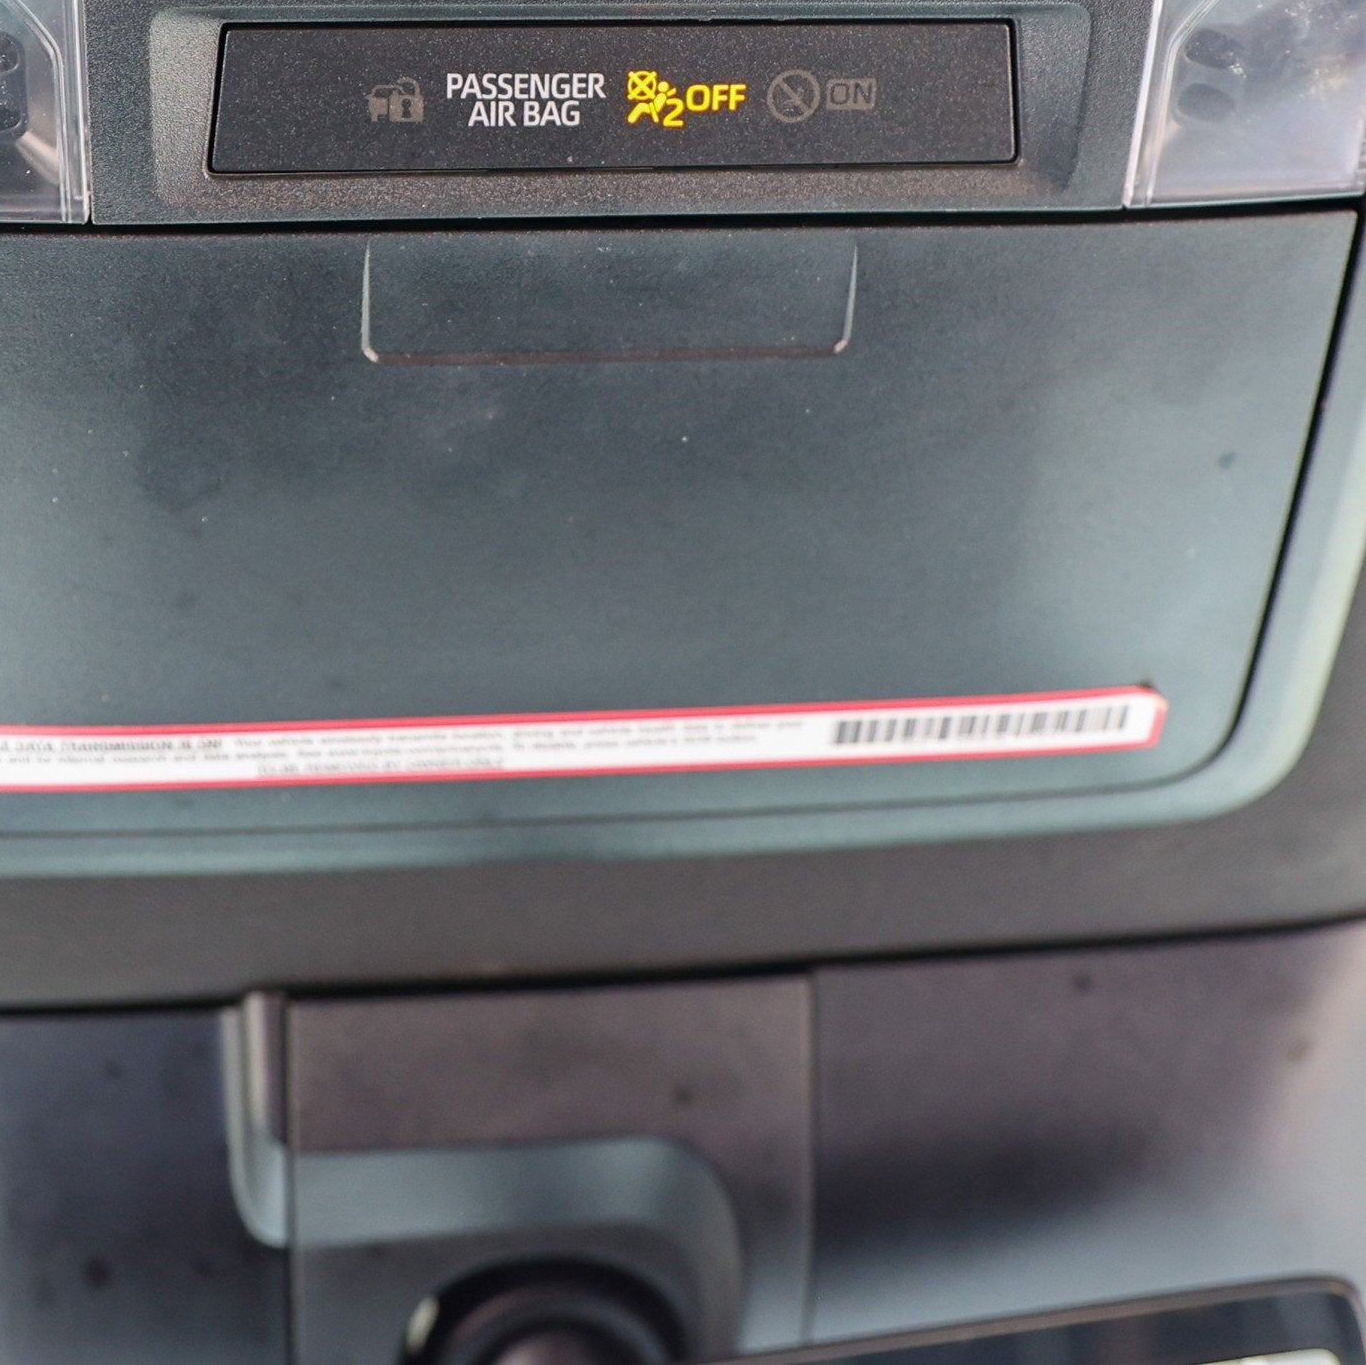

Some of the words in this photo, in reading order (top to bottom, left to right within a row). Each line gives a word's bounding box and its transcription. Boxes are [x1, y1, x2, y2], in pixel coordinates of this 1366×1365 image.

[445, 72, 607, 100] PASSENGER
[685, 83, 748, 112] OFF
[829, 81, 874, 106] ON
[467, 100, 517, 127] AIR
[522, 100, 581, 127] BAG
